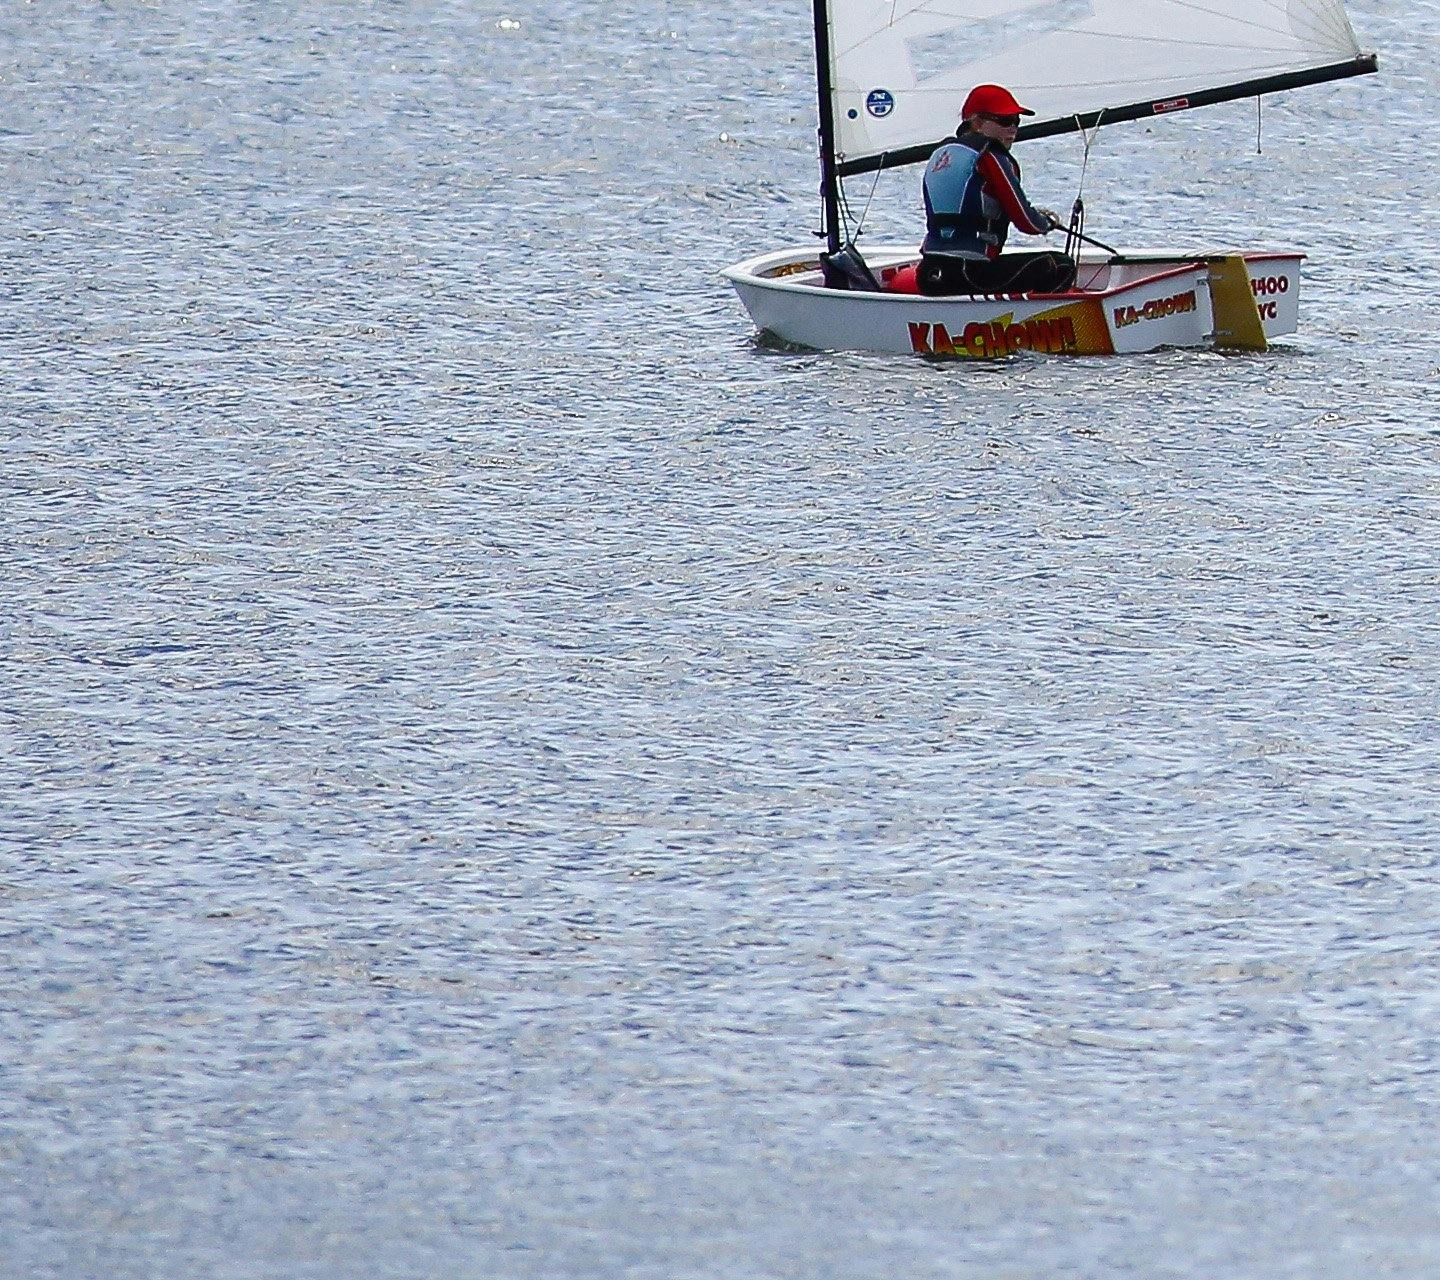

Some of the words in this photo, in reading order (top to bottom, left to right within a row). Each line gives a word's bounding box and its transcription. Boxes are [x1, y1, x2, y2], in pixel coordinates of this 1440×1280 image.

[1250, 275, 1289, 297] 1400
[1113, 290, 1197, 329] KA-CHOW!
[908, 317, 1077, 357] KA-CHOW!
